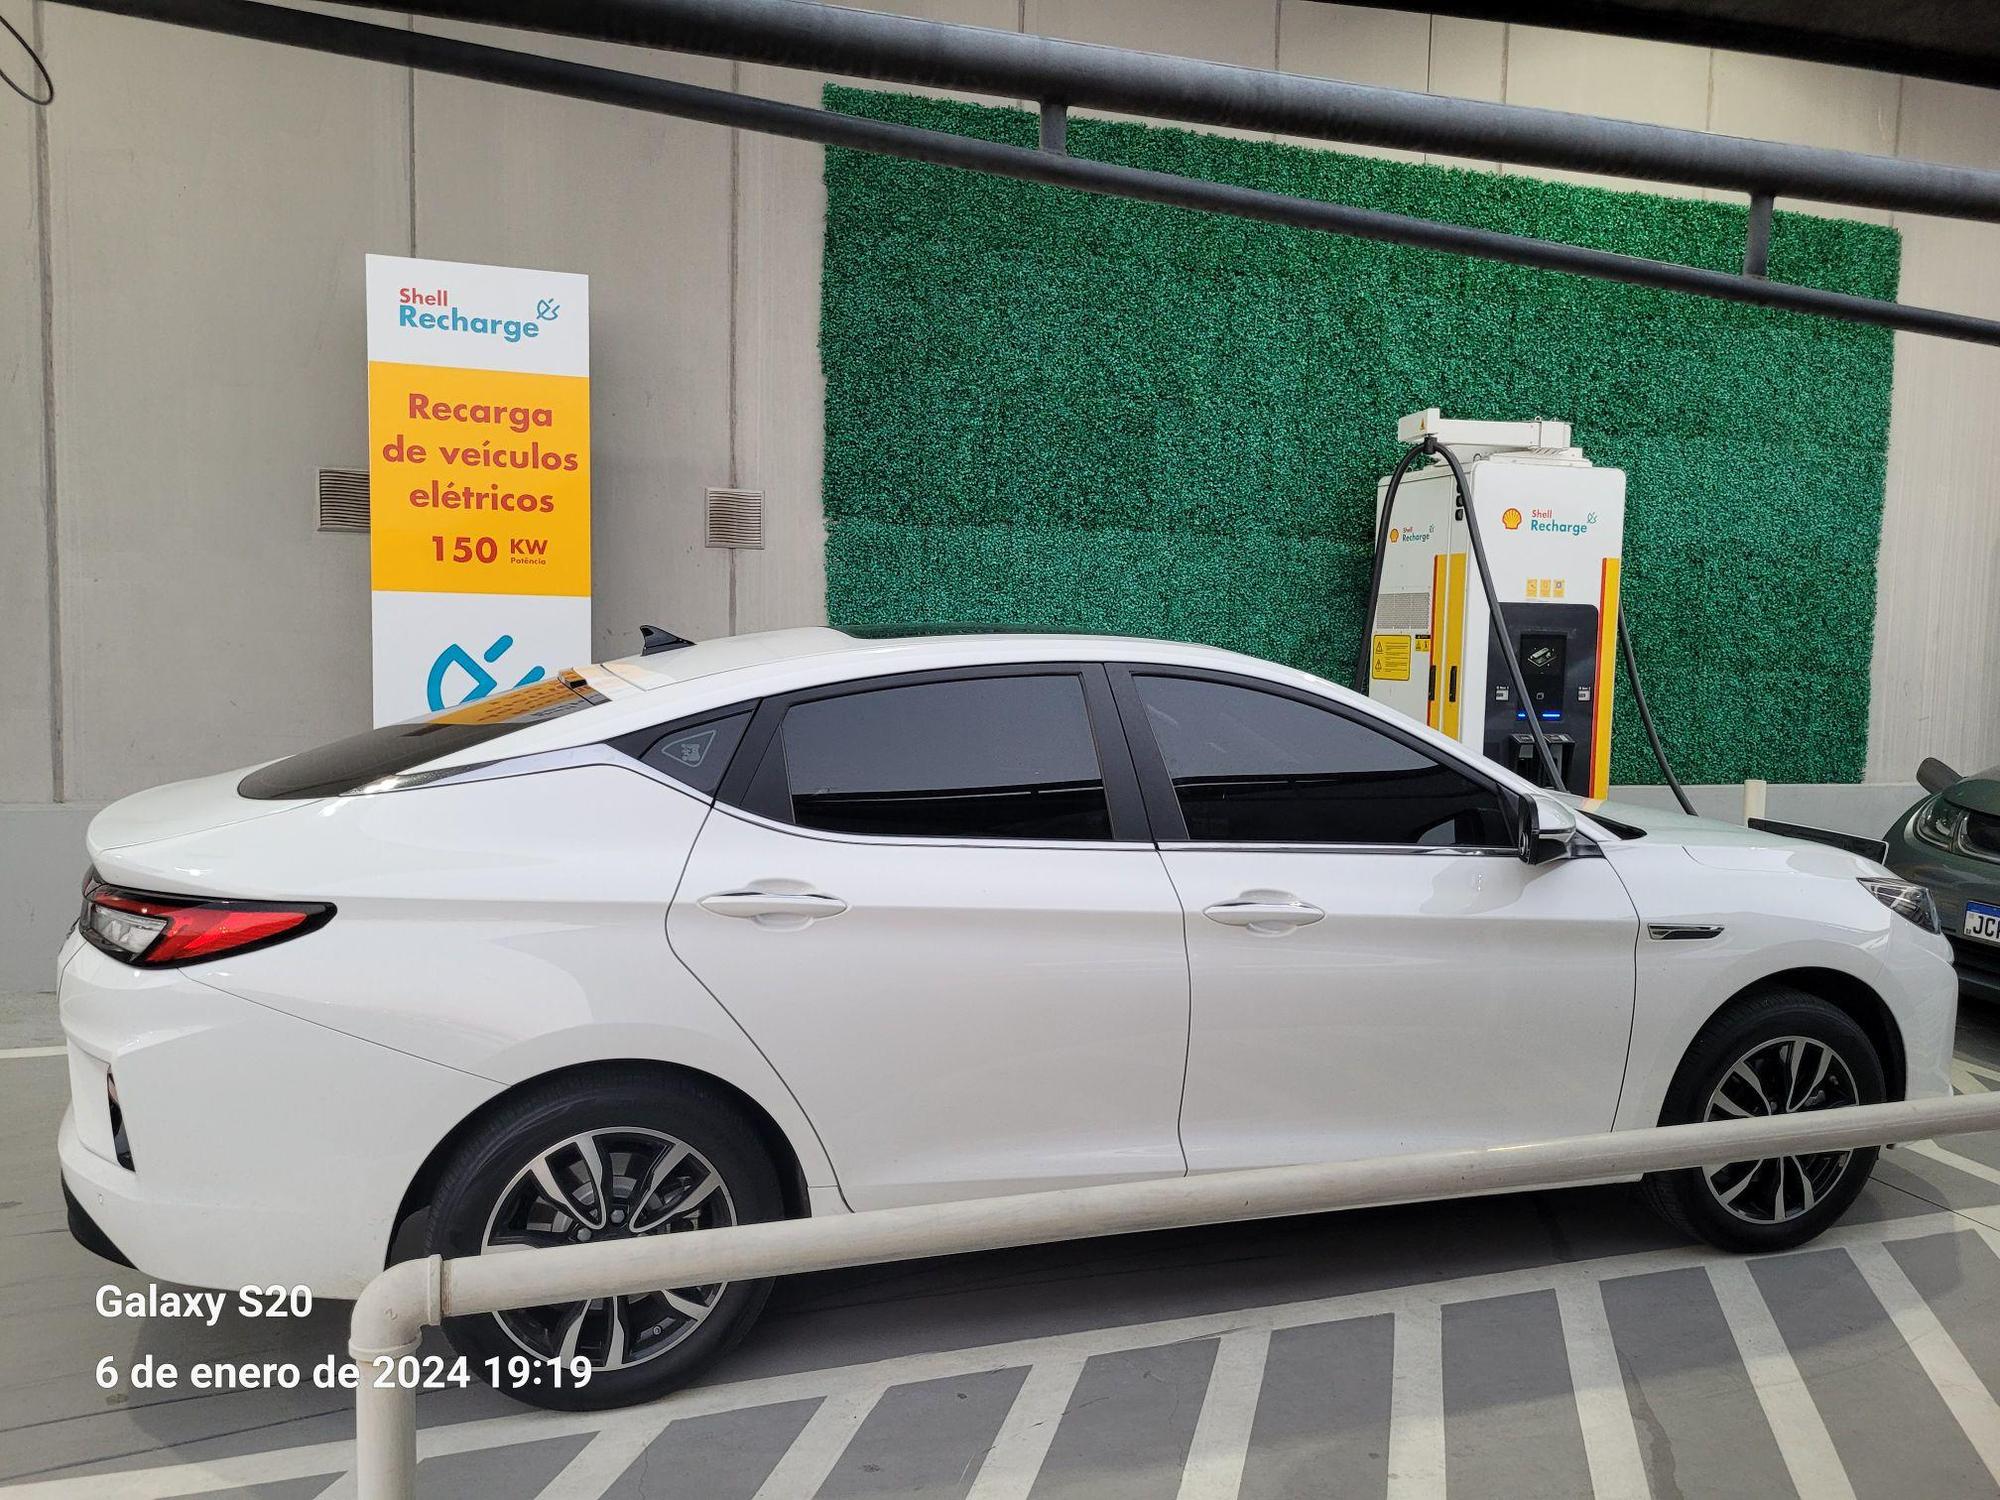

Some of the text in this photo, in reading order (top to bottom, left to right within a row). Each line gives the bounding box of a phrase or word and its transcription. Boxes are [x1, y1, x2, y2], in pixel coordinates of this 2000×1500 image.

[399, 287, 448, 307] Shell
[399, 304, 540, 343] Recharge
[408, 392, 553, 434] Recarga
[382, 433, 579, 472] de veículos
[409, 479, 555, 514] elétricos
[1530, 519, 1588, 536] Recharge
[1531, 508, 1553, 519] Shell
[431, 535, 549, 564] 150 KW
